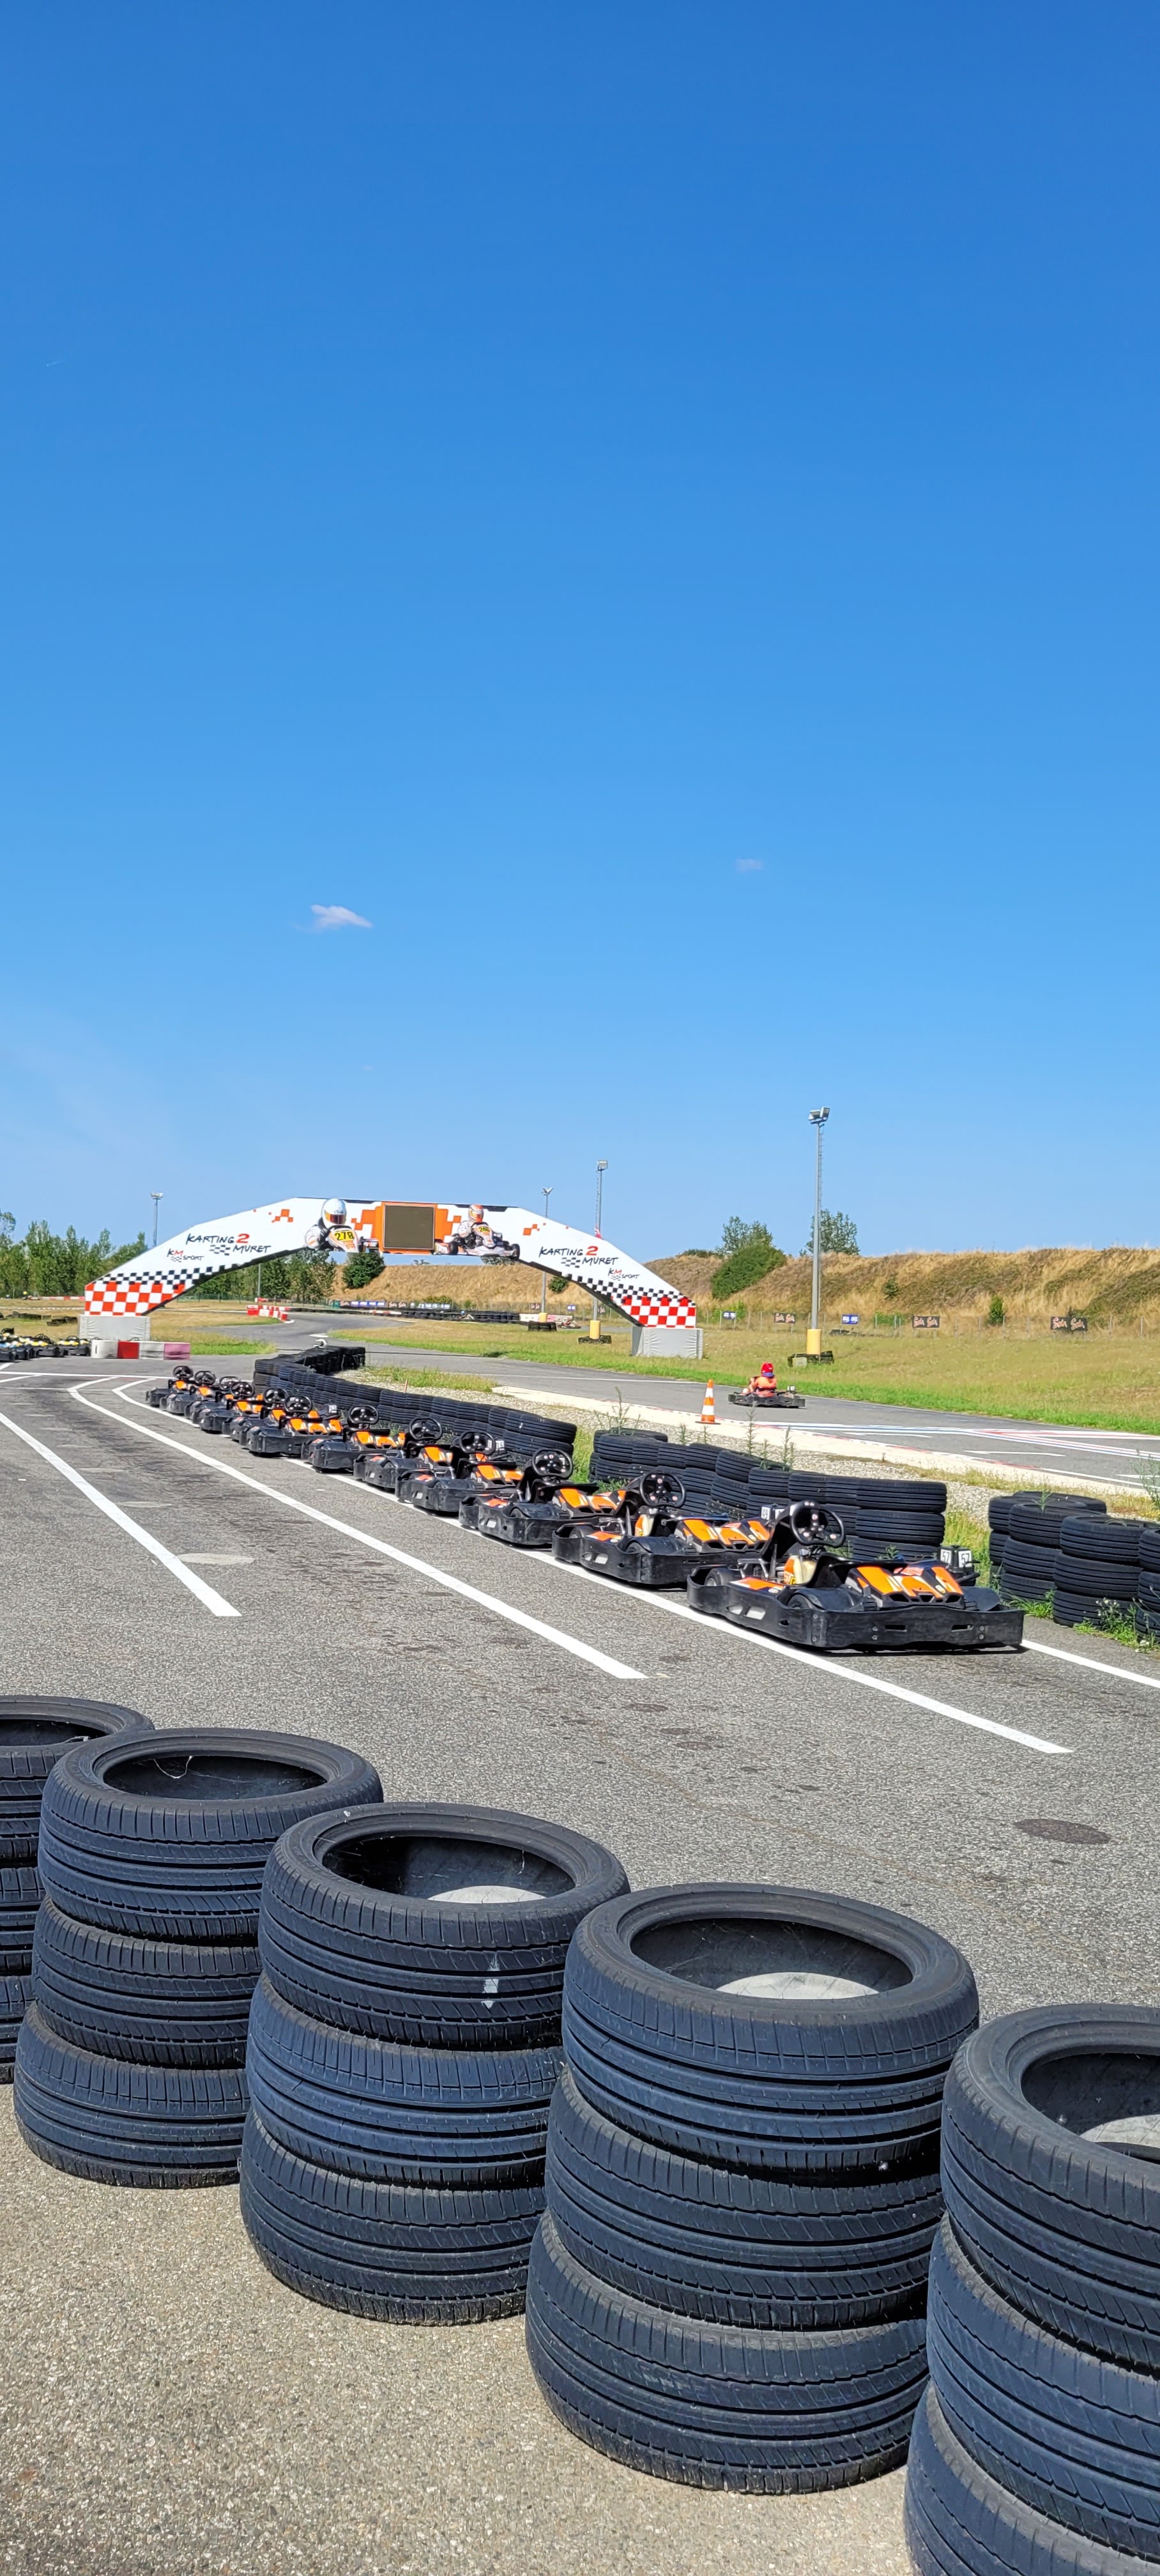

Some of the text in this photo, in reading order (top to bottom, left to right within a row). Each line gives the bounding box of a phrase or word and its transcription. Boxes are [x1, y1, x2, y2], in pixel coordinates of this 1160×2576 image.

[186, 1233, 250, 1245] KARTING 2
[335, 1231, 355, 1241] 278
[167, 1248, 183, 1257] KM
[233, 1245, 271, 1253] MURET
[538, 1246, 599, 1258] KARTING 2
[582, 1257, 619, 1266] MURET
[608, 1268, 622, 1276] KM
[942, 1551, 950, 1563] 57
[961, 1552, 970, 1565] 57
